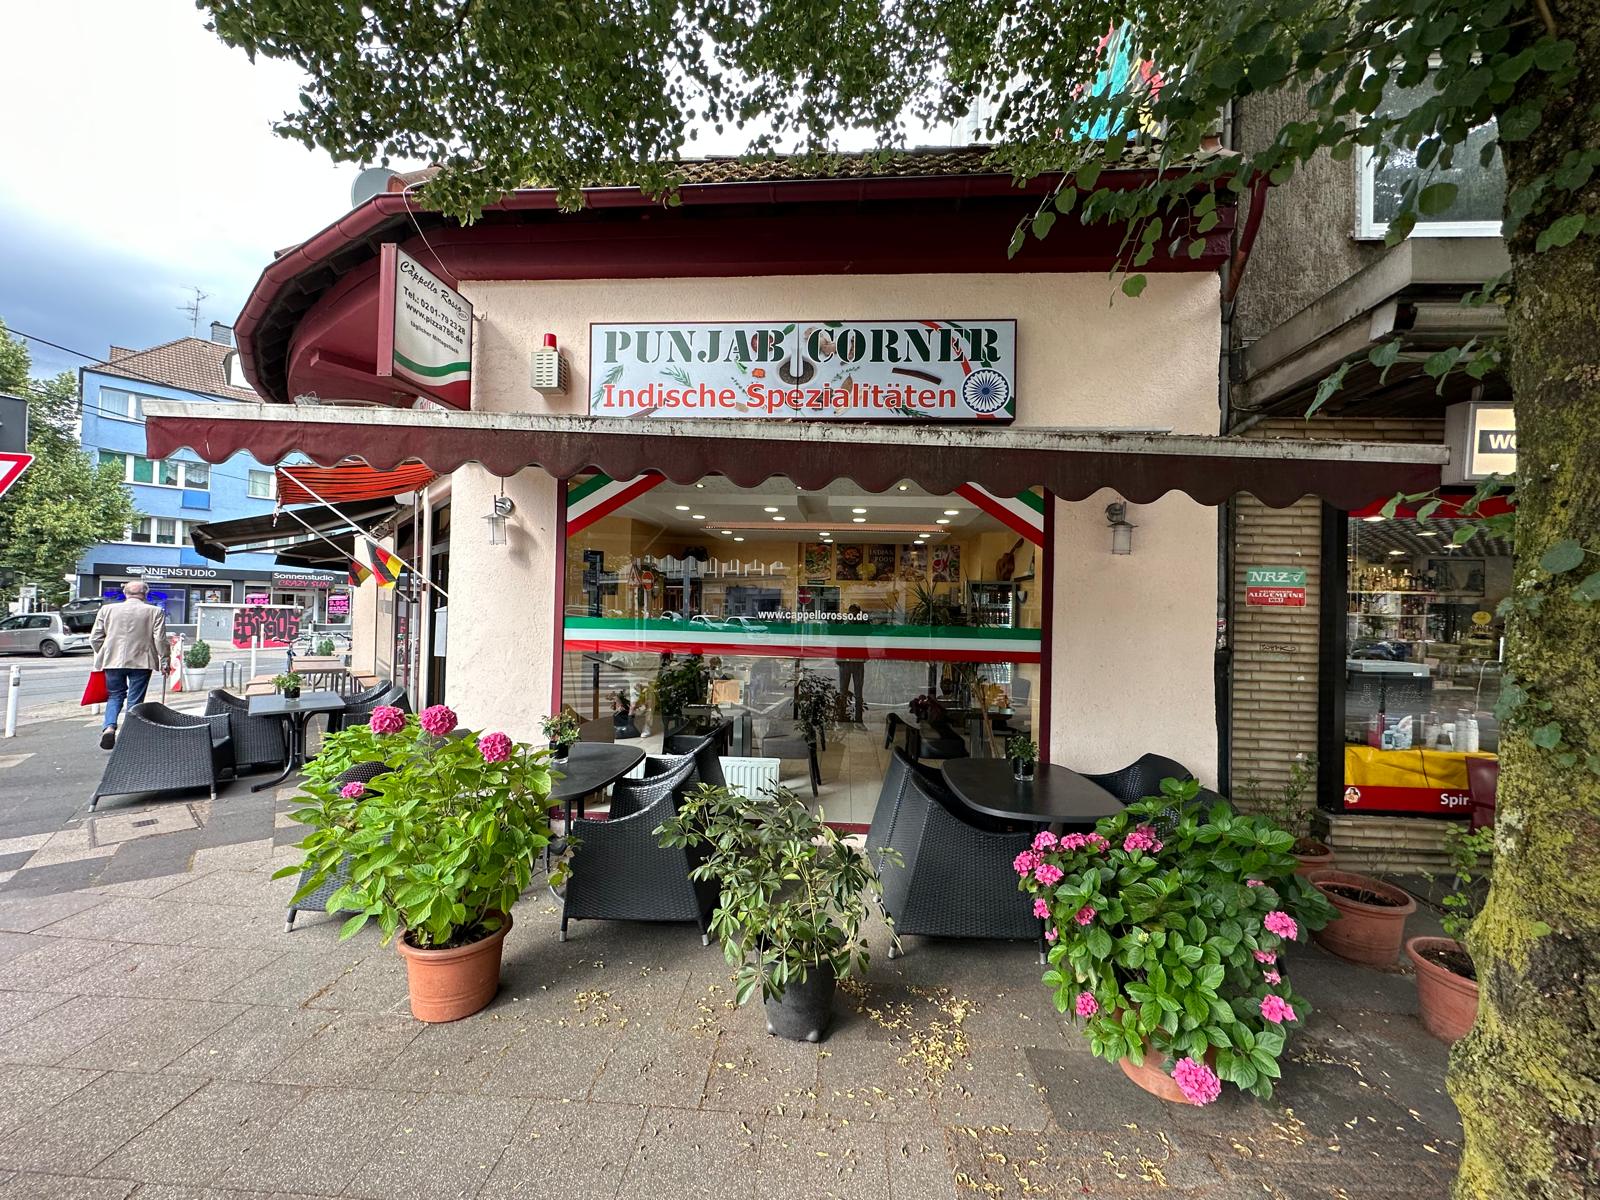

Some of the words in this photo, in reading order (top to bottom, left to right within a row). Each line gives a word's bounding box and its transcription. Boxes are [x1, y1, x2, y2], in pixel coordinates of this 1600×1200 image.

[603, 329, 786, 364] PUNJAB
[806, 328, 1001, 363] CORNER
[603, 383, 736, 409] Indische
[746, 383, 957, 414] Spezialitäten
[126, 566, 217, 578] SNNENSTUDIO
[273, 572, 334, 581] Sonnenstudio
[1248, 571, 1291, 583] NRZ
[758, 610, 869, 621] www.cappellorosso.de
